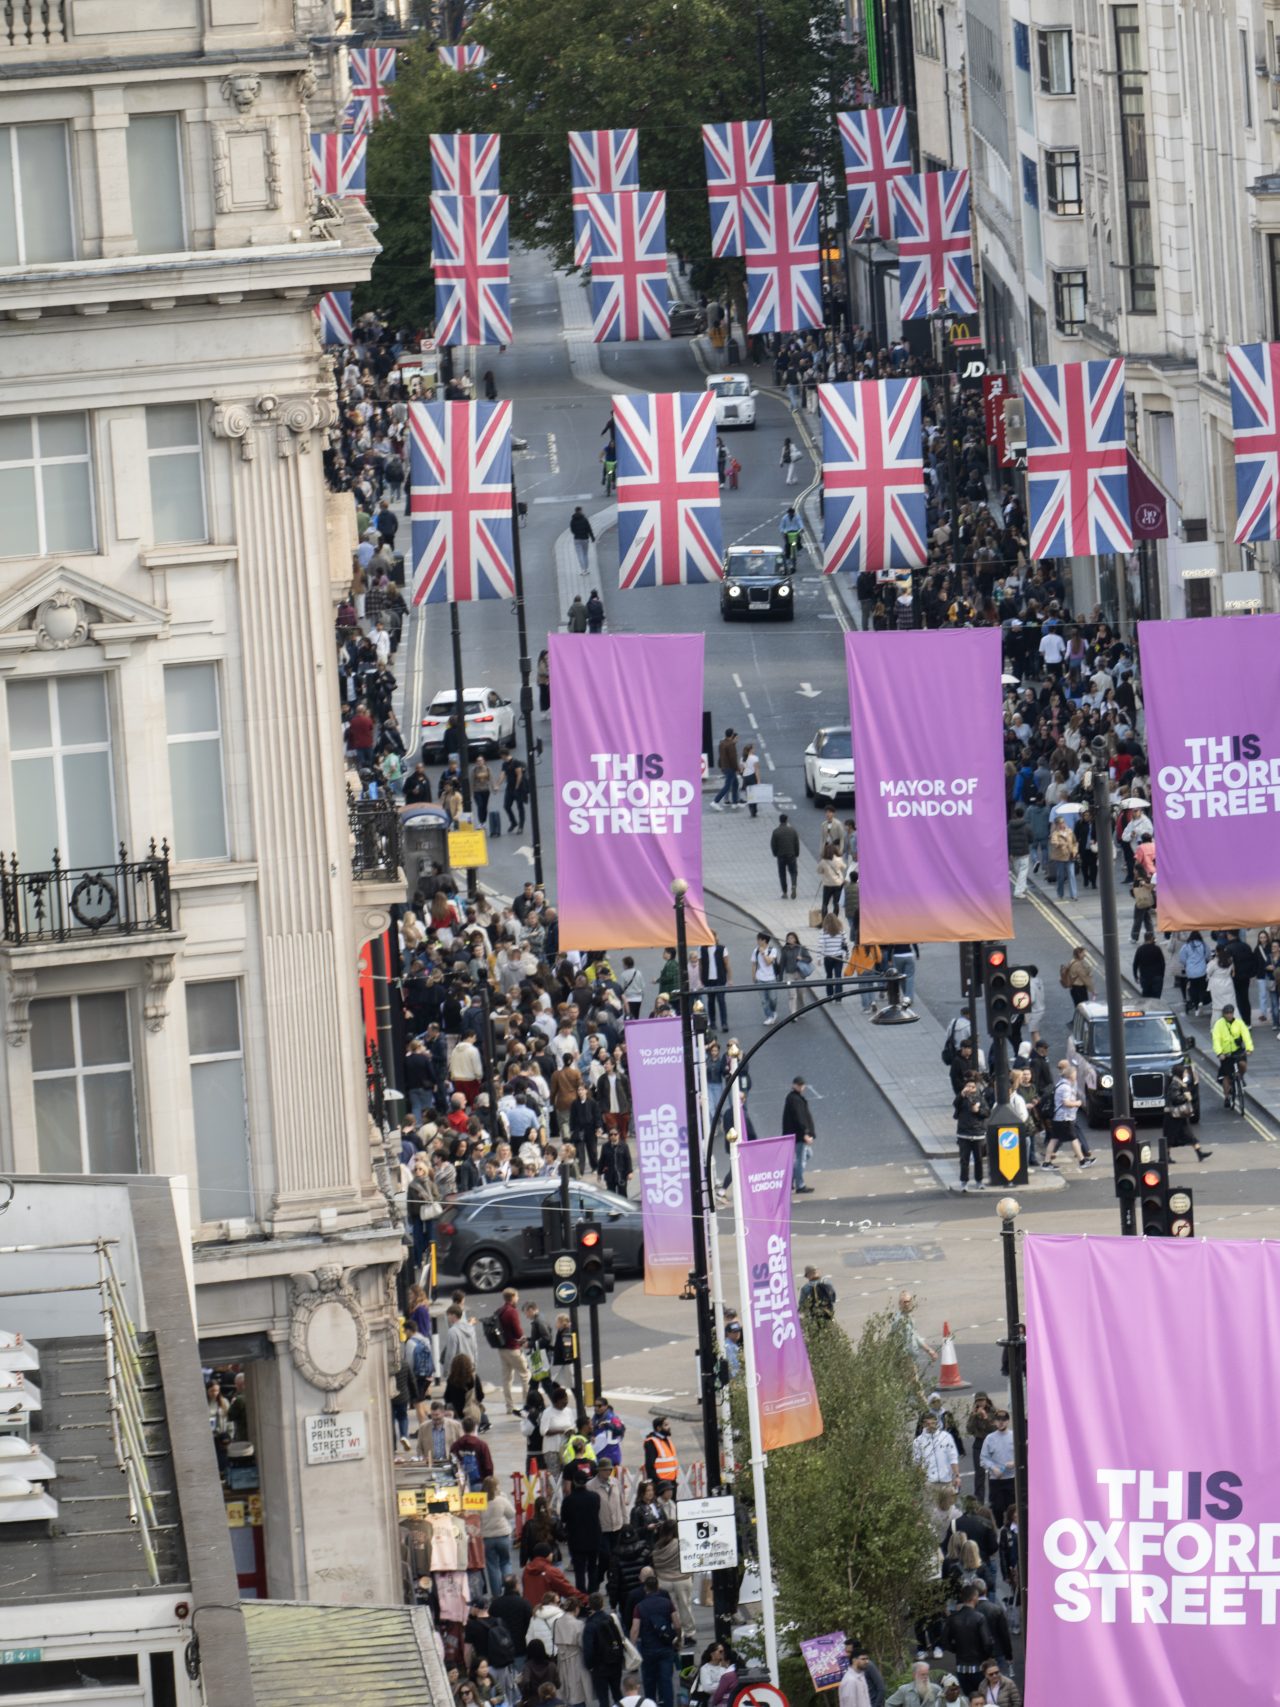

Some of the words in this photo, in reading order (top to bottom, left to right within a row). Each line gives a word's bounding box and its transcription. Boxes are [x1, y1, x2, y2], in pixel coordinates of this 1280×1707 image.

[962, 361, 985, 379] JD
[1185, 734, 1261, 764] THIS
[591, 753, 664, 781] THIS
[562, 780, 694, 808] OXFORD
[880, 779, 946, 797] MAYOR
[951, 778, 978, 795] OF
[888, 800, 973, 817] LONDON
[569, 806, 690, 834] STREET
[748, 1171, 772, 1184] MAYOR
[773, 1169, 785, 1179] OF
[752, 1180, 783, 1193] LONDON
[752, 1263, 772, 1328] THIS
[767, 1234, 785, 1349] OXFORD
[311, 1418, 336, 1430] JOHN
[312, 1440, 344, 1452] STREET
[349, 1438, 360, 1447] W1
[465, 1496, 484, 1505] SALE
[1097, 1468, 1242, 1520] THIS
